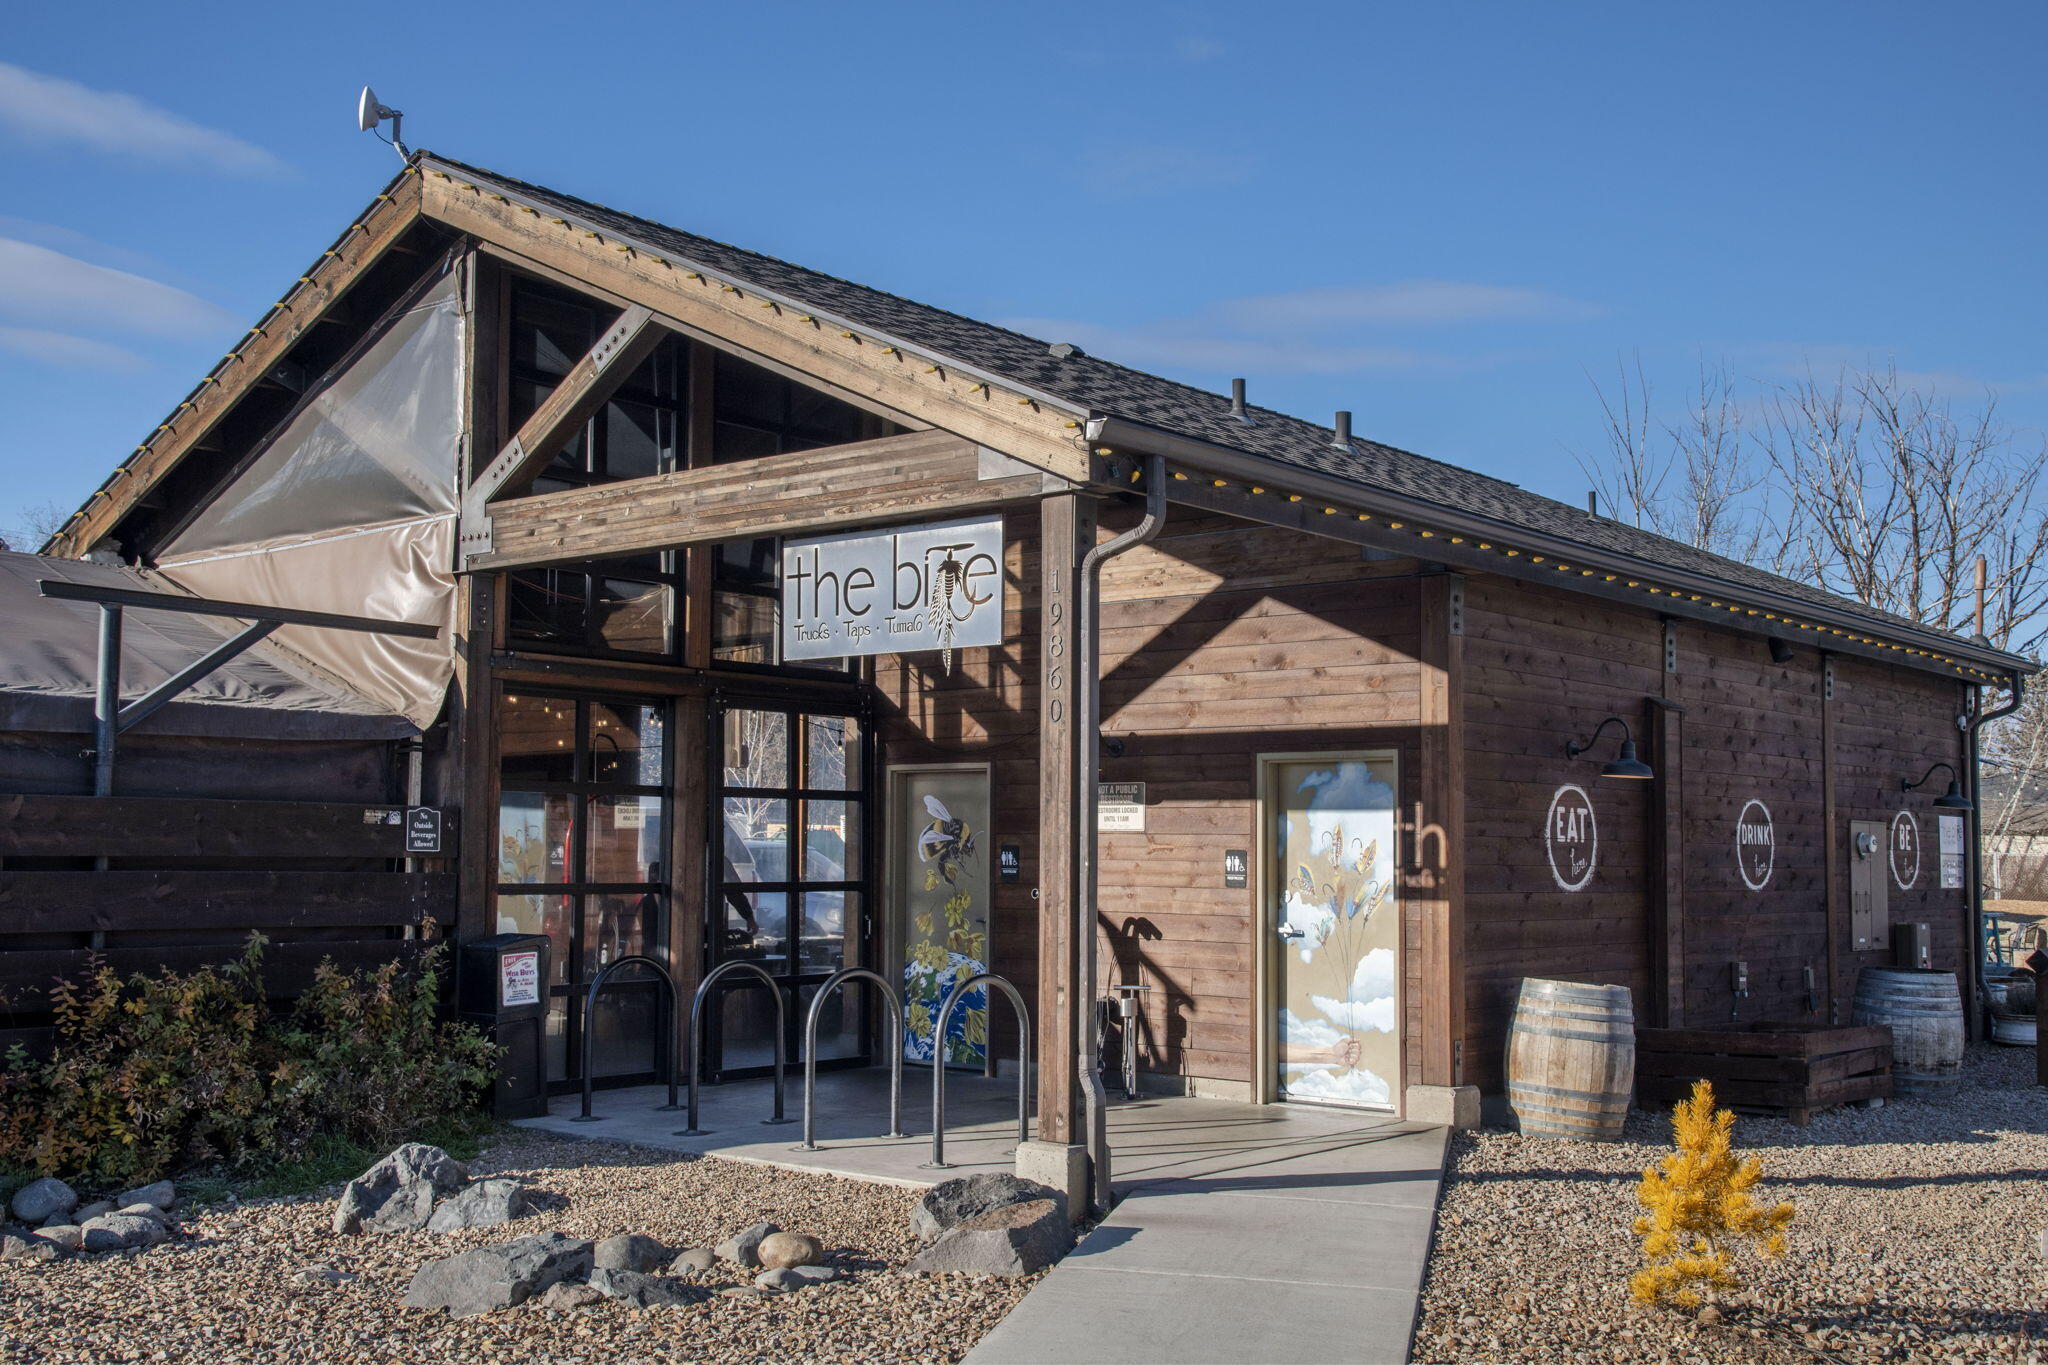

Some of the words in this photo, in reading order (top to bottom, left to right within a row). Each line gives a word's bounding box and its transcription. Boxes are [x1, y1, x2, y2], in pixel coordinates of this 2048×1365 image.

[786, 547, 876, 620] the
[892, 534, 997, 622] bite
[794, 622, 830, 642] Trucks
[843, 620, 870, 646] Taps
[884, 614, 924, 634] Tumalo
[1049, 569, 1064, 723] 19860
[1110, 785, 1114, 794] A
[1115, 785, 1138, 794] PUBLIC
[410, 831, 436, 839] Beverages
[1556, 806, 1588, 843] EAT
[1741, 824, 1770, 846] DRINK
[1899, 824, 1911, 850] BE
